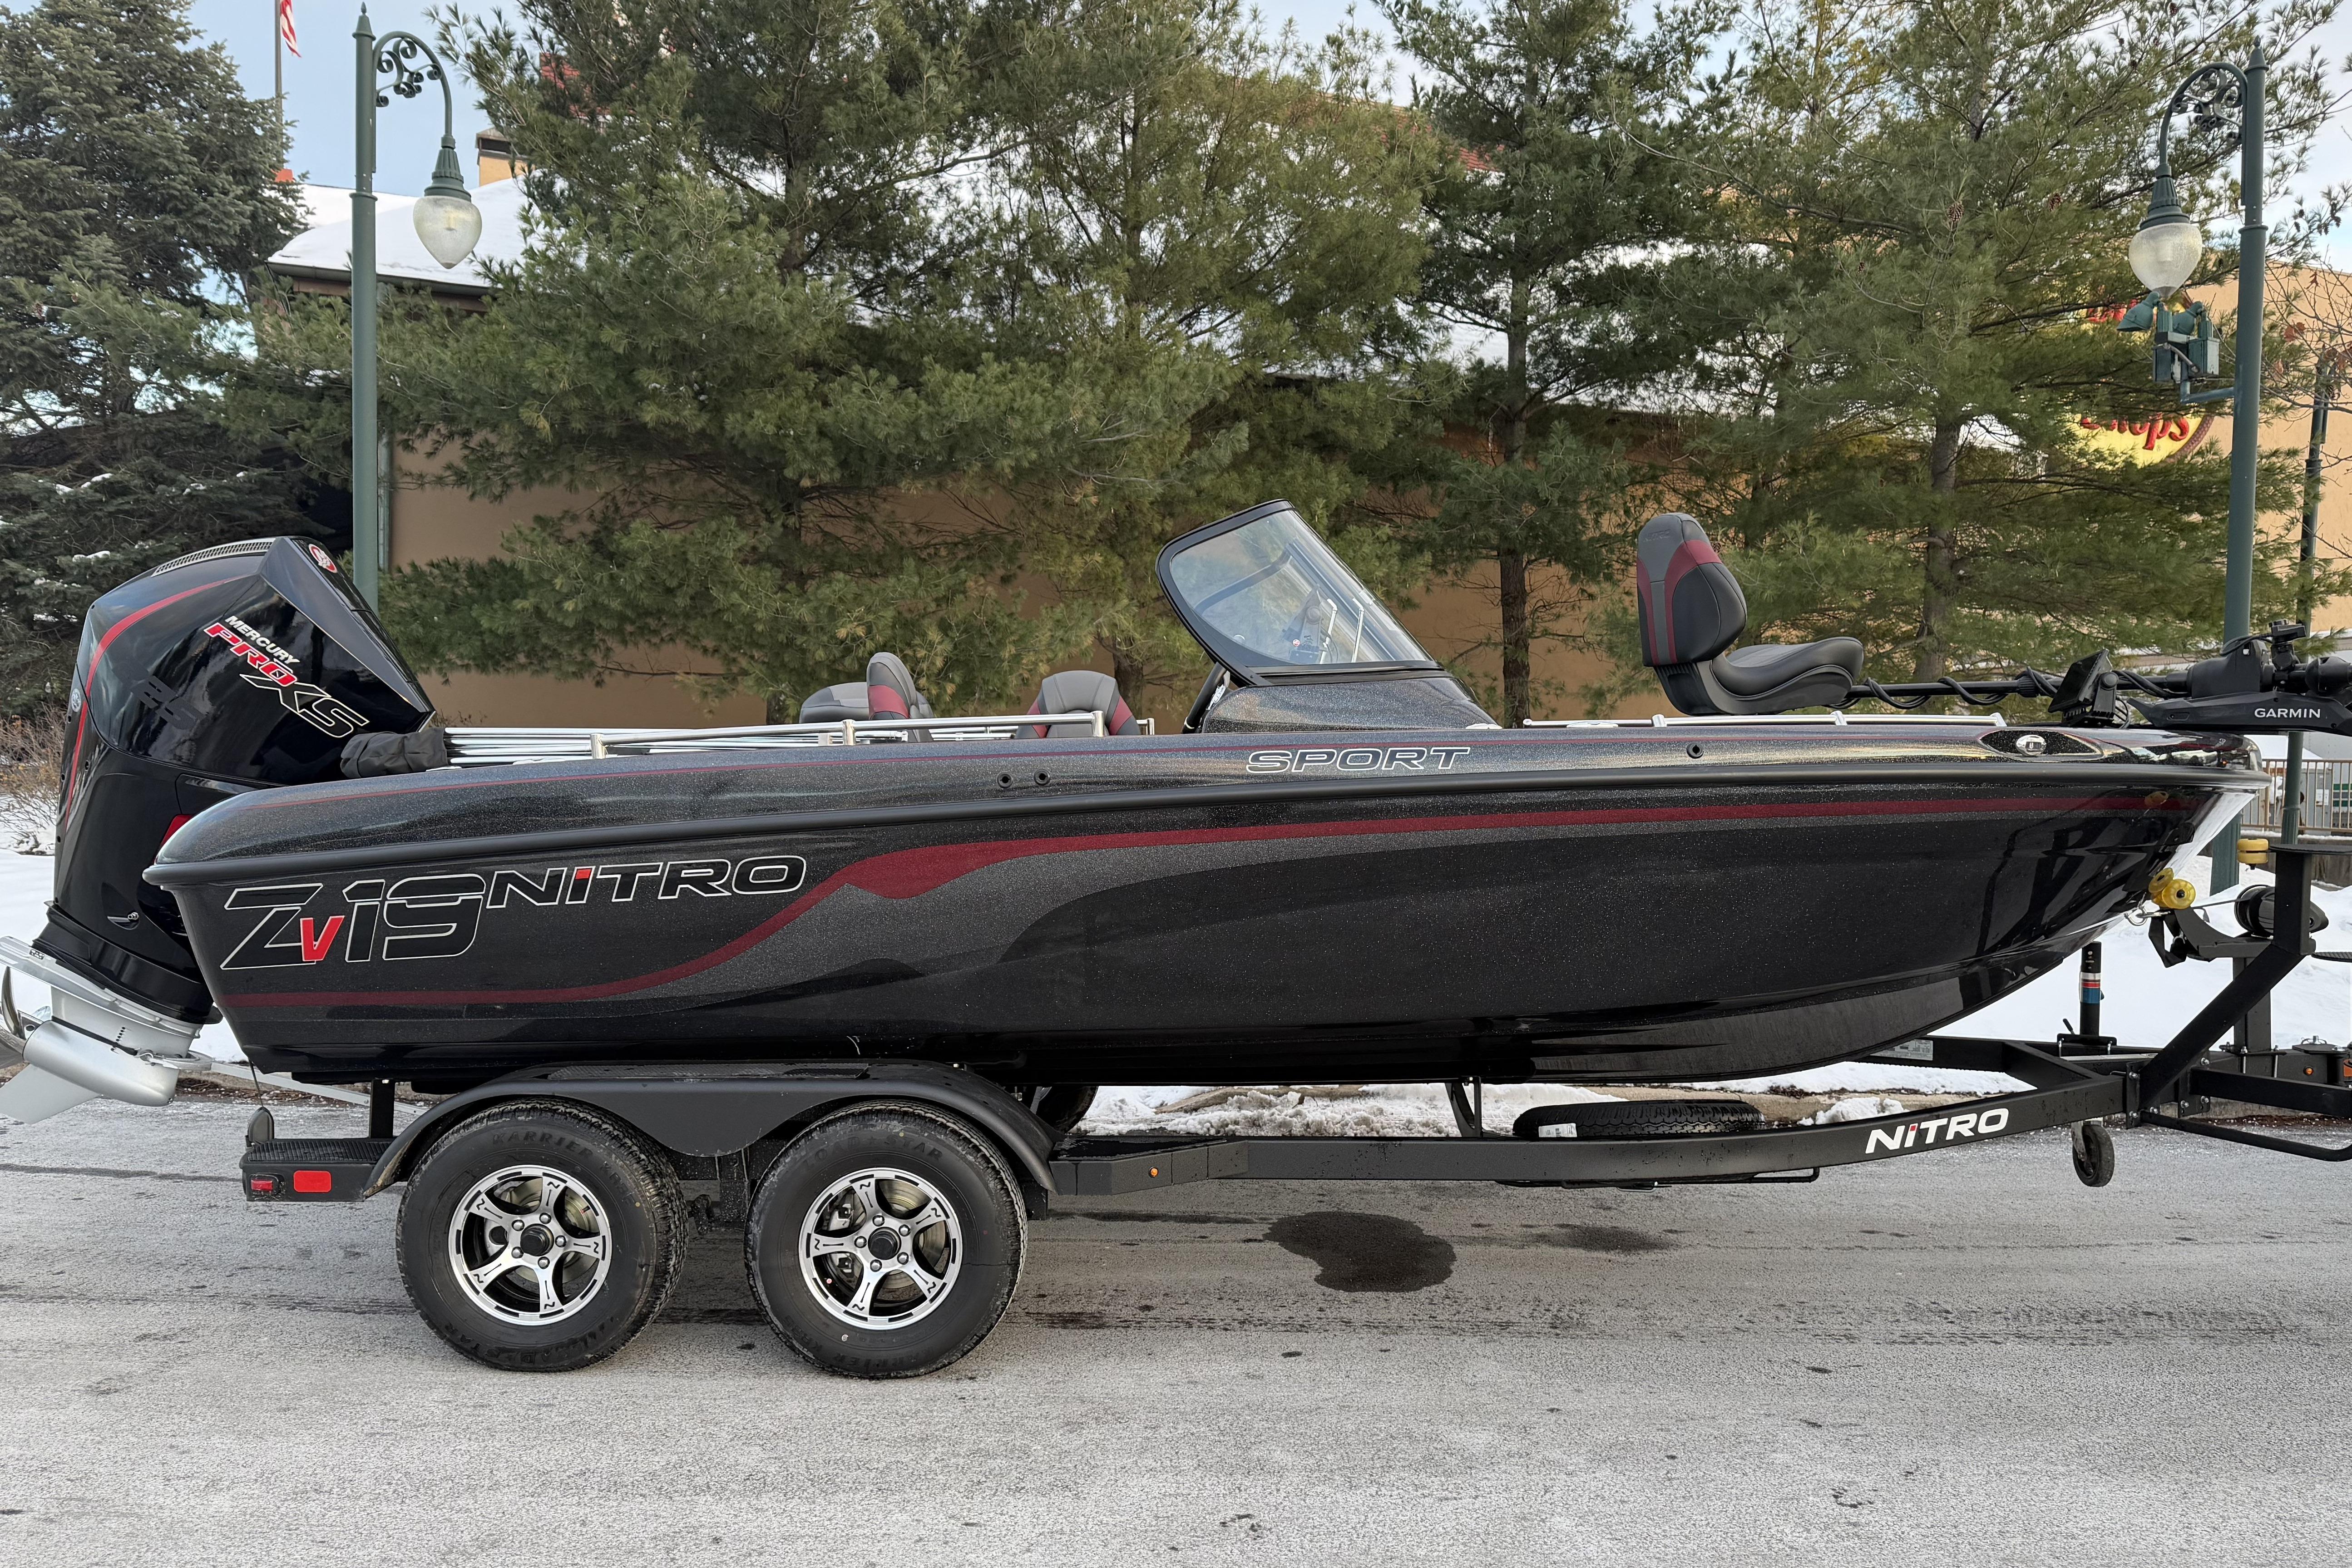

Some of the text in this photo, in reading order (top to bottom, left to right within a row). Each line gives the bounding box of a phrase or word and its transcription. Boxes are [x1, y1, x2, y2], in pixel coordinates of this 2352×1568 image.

[204, 622, 297, 687] PRO
[225, 615, 300, 664] MERCURY
[240, 673, 370, 738] XS
[2254, 708, 2321, 718] GARMIN
[1246, 747, 1471, 773] SPORT
[1865, 1108, 2009, 1154] NITRO
